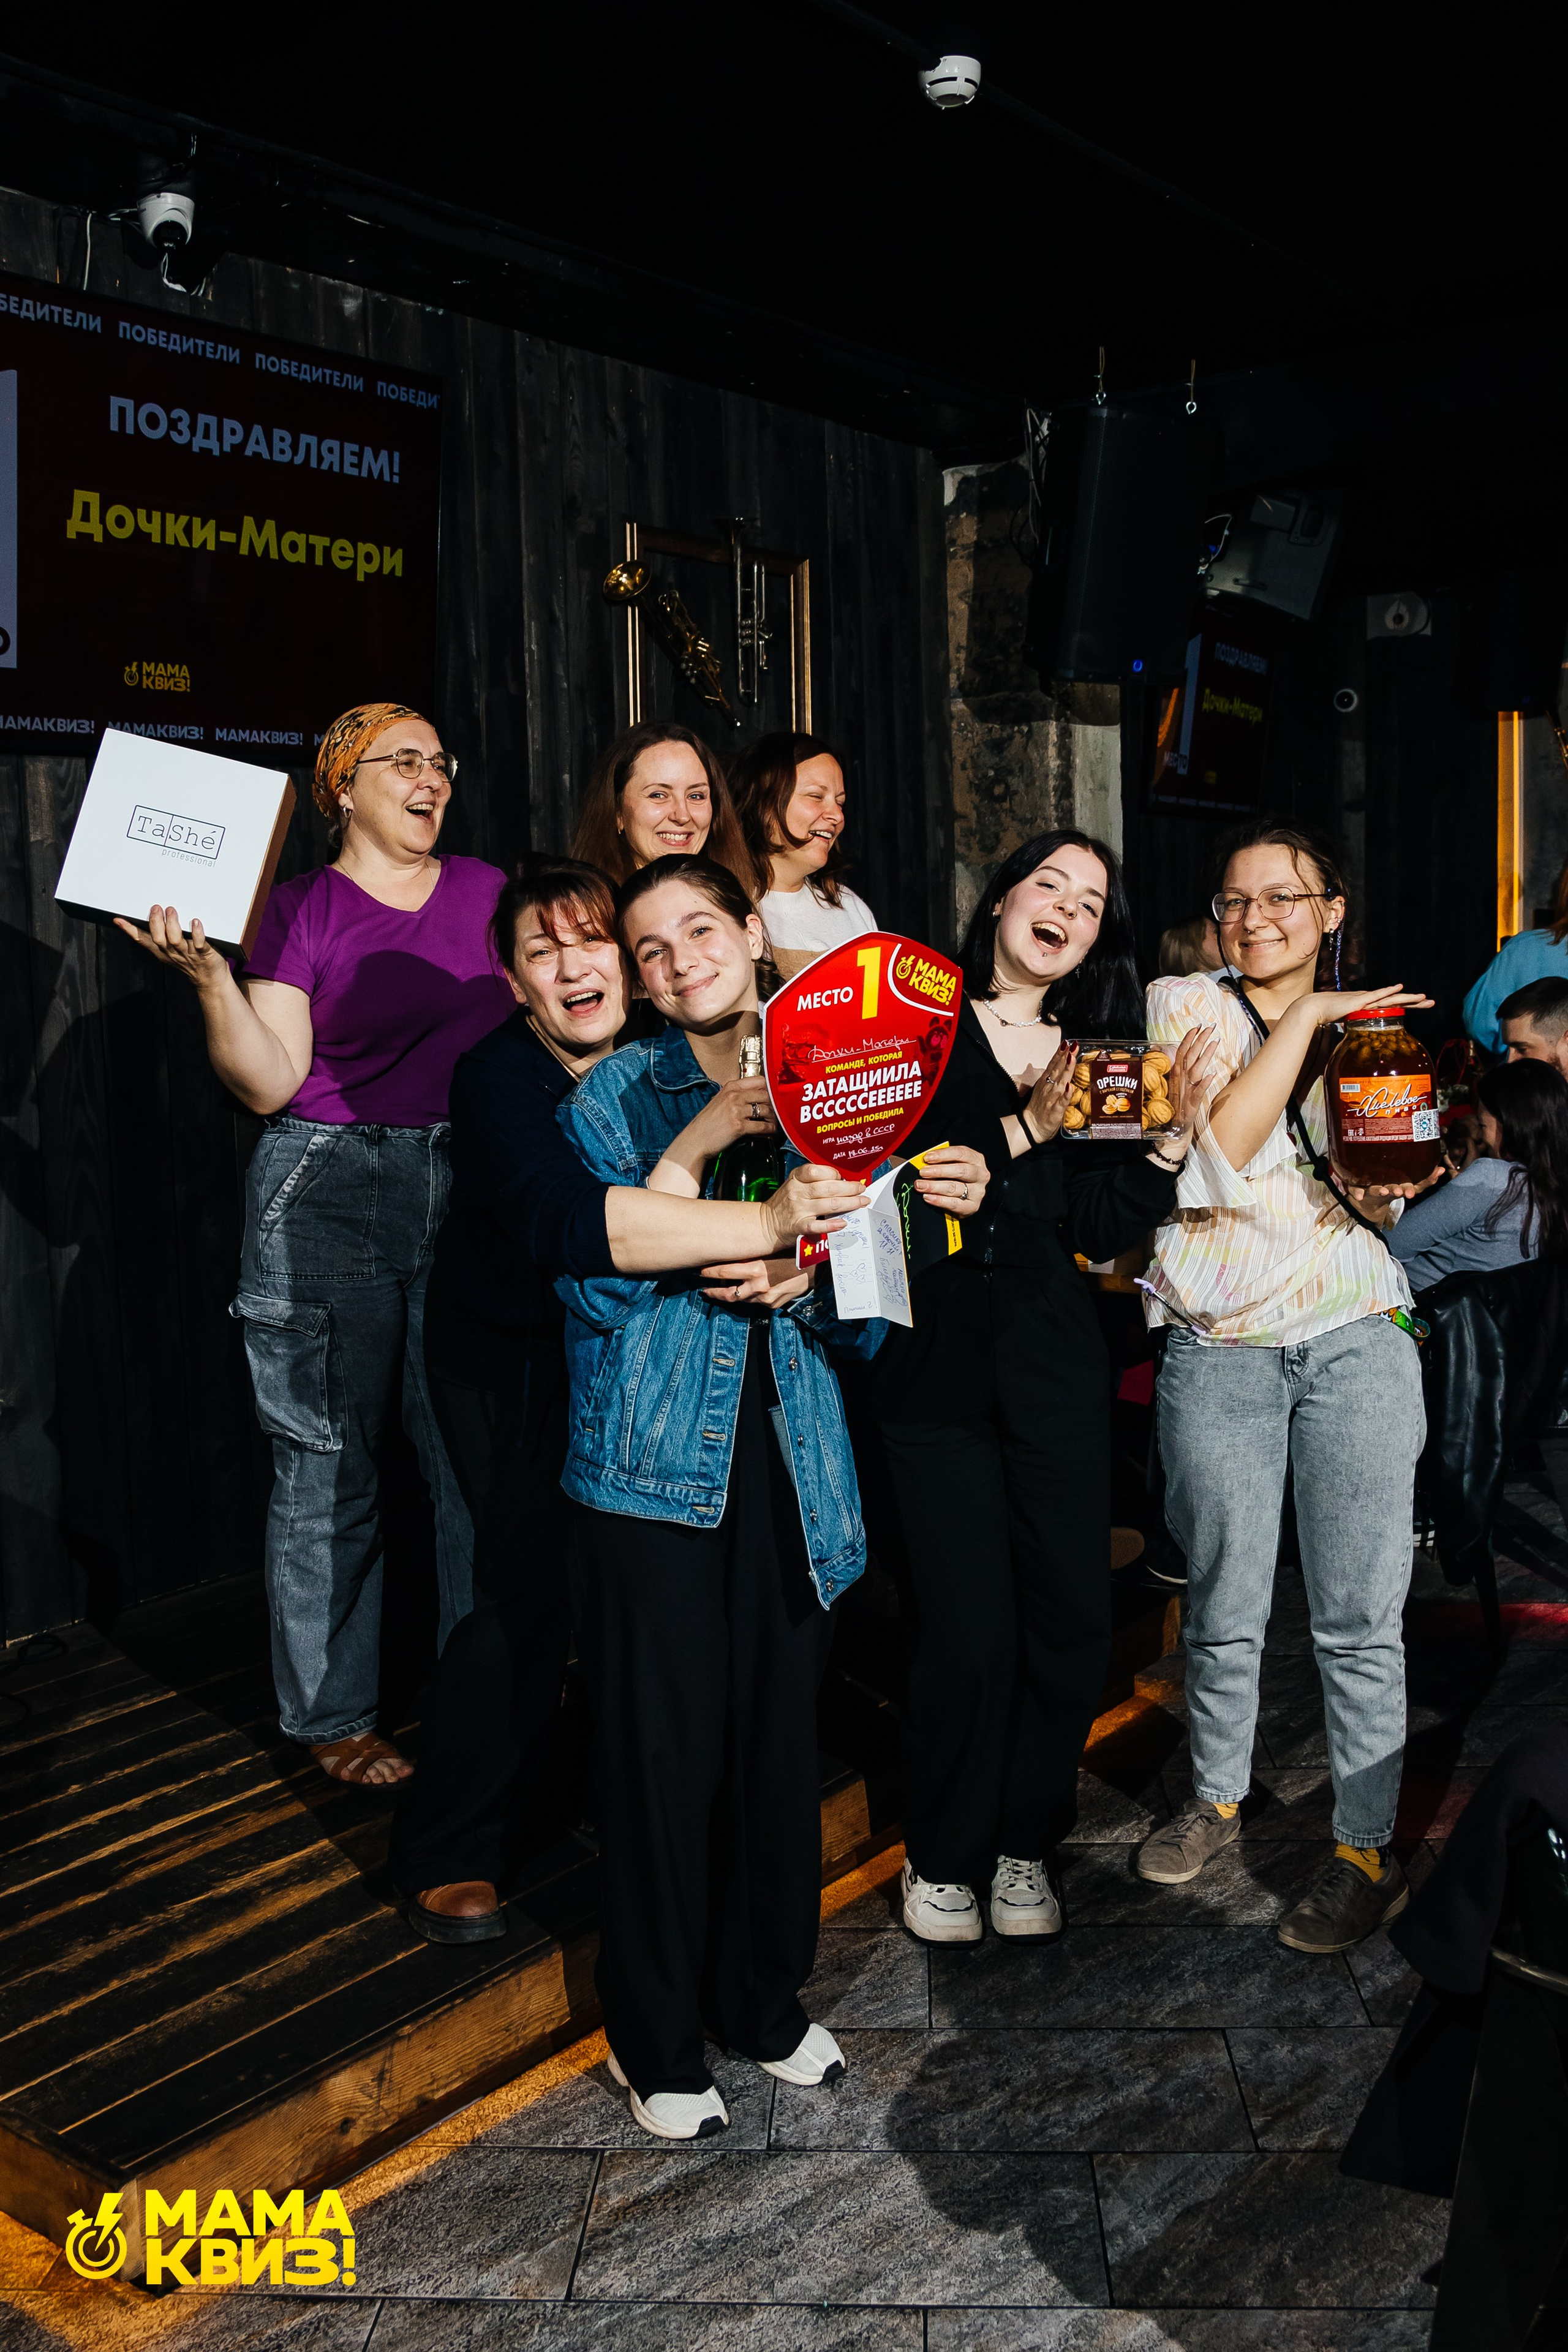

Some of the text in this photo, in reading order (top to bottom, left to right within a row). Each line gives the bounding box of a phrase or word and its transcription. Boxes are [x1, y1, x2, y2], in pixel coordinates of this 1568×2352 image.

[119, 320, 240, 364] ПОБЕДИТЕЛИ
[255, 353, 364, 392] ПОБЕДИТЕЛИ
[377, 380, 440, 409] ПОБЕДИ
[110, 396, 401, 483] ПОЗДРАВЛЯЕМ!
[67, 489, 403, 581] Дочки-Матери
[142, 662, 190, 678] МАМА
[142, 676, 190, 692] КВИЗ!
[215, 727, 303, 746] МАМАКВИЗ!
[161, 848, 216, 867] professional
[797, 946, 881, 1020] МЕСТО 1
[908, 972, 955, 1006] КВИЗ!
[913, 958, 957, 990] МАМА
[825, 1051, 903, 1074] КОМАНДЕ, КОТОРАЯ
[802, 1061, 921, 1101] ЗАТАЩИИЛА
[1096, 1076, 1138, 1090] ОРЕШКИ
[800, 1080, 922, 1123] ВСССССЕЕЕЕЕЕ
[816, 1107, 904, 1134] ВОПРОСЫ И ПОБЕДИЛА
